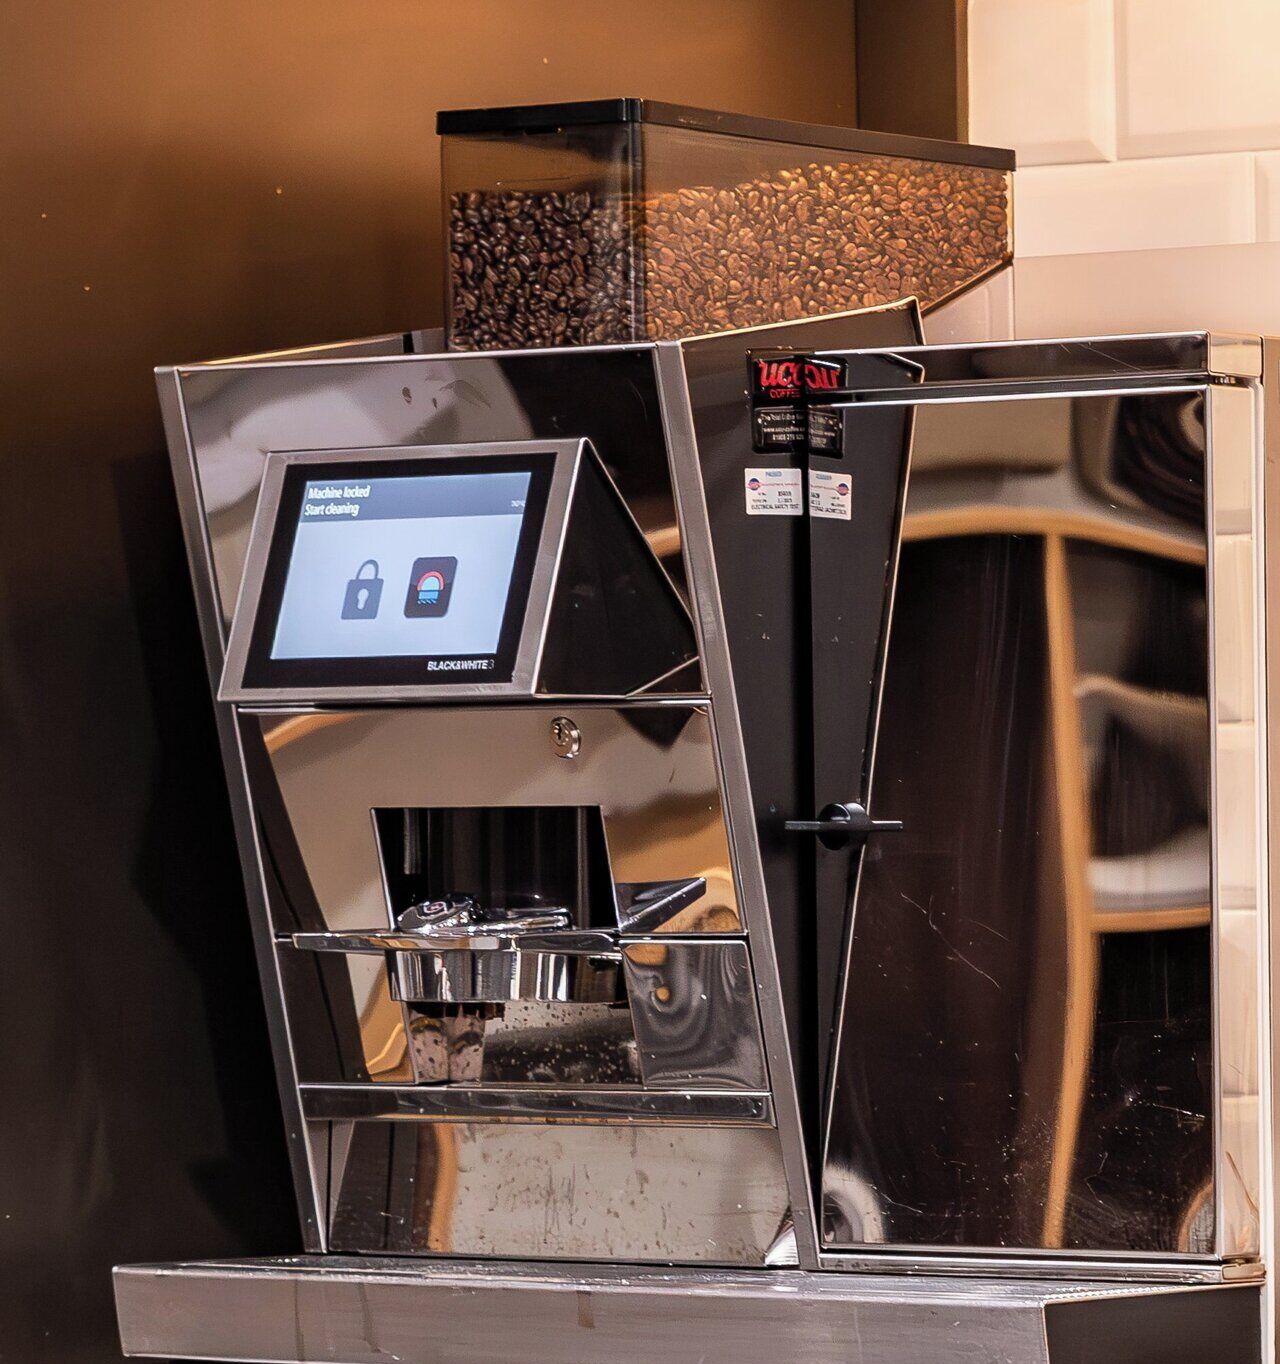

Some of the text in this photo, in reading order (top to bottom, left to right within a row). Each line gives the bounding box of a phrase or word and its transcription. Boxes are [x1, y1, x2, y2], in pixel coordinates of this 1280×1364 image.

[308, 485, 371, 499] Machine locked
[305, 503, 360, 517] Start cleaning
